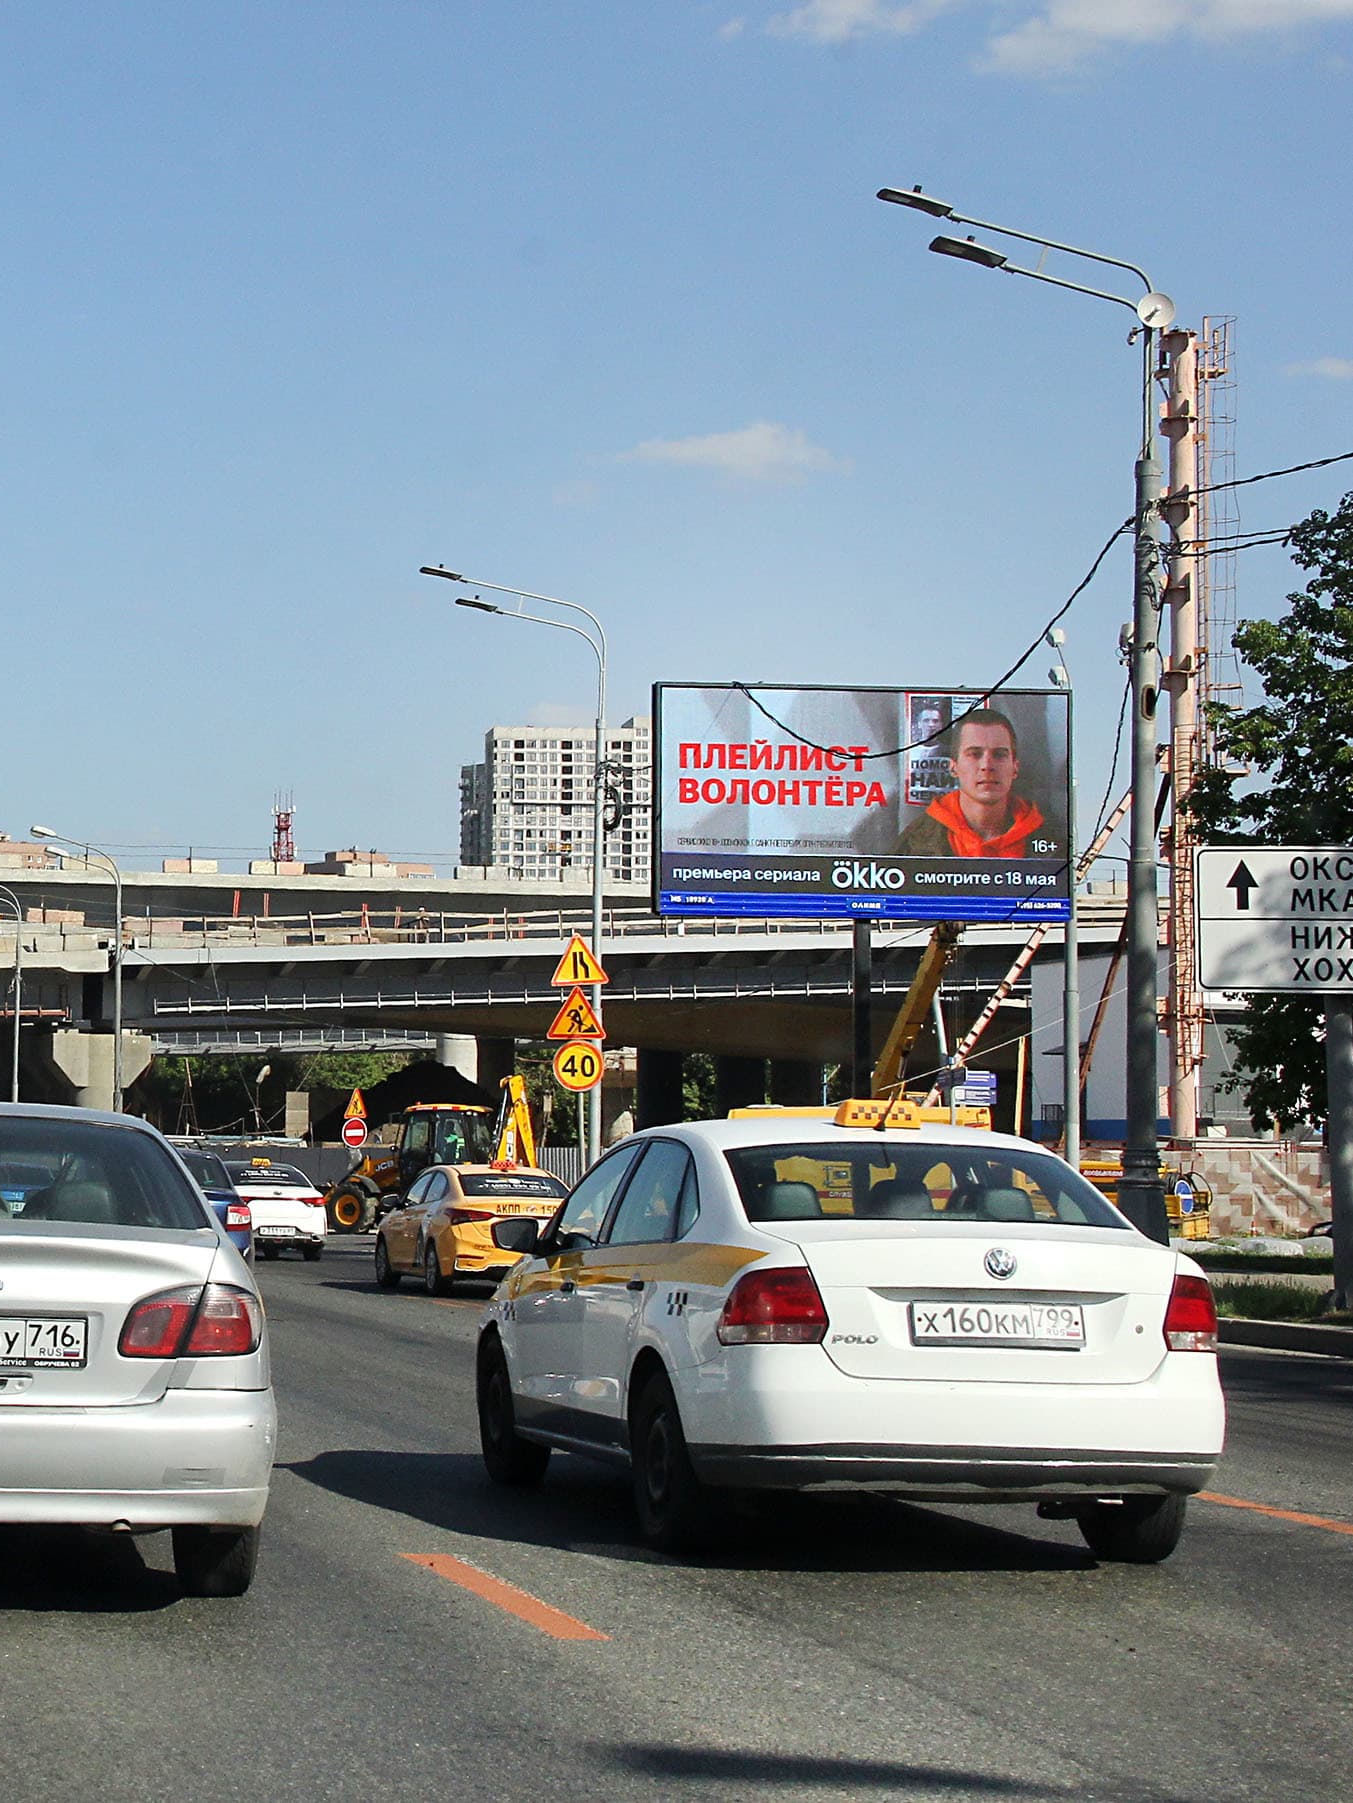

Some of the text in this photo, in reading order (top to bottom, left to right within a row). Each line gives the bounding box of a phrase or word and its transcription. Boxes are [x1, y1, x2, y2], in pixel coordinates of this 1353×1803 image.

[679, 739, 869, 772] ПЛЕЙЛИСТ
[679, 776, 888, 807] ВОЛОНТЁРА
[1032, 839, 1058, 853] 16+
[672, 867, 821, 882] премьера сериала
[1290, 856, 1353, 881] ОКС
[914, 872, 1057, 886] смотрите с 18 мая
[562, 1055, 595, 1077] 40
[375, 1160, 395, 1172] JCB
[497, 1204, 521, 1214] АКПП
[923, 1307, 1074, 1335] Х160КМ 799
[29, 1324, 75, 1348] 716
[831, 1335, 879, 1344] POLO
[39, 1347, 63, 1357] RUS
